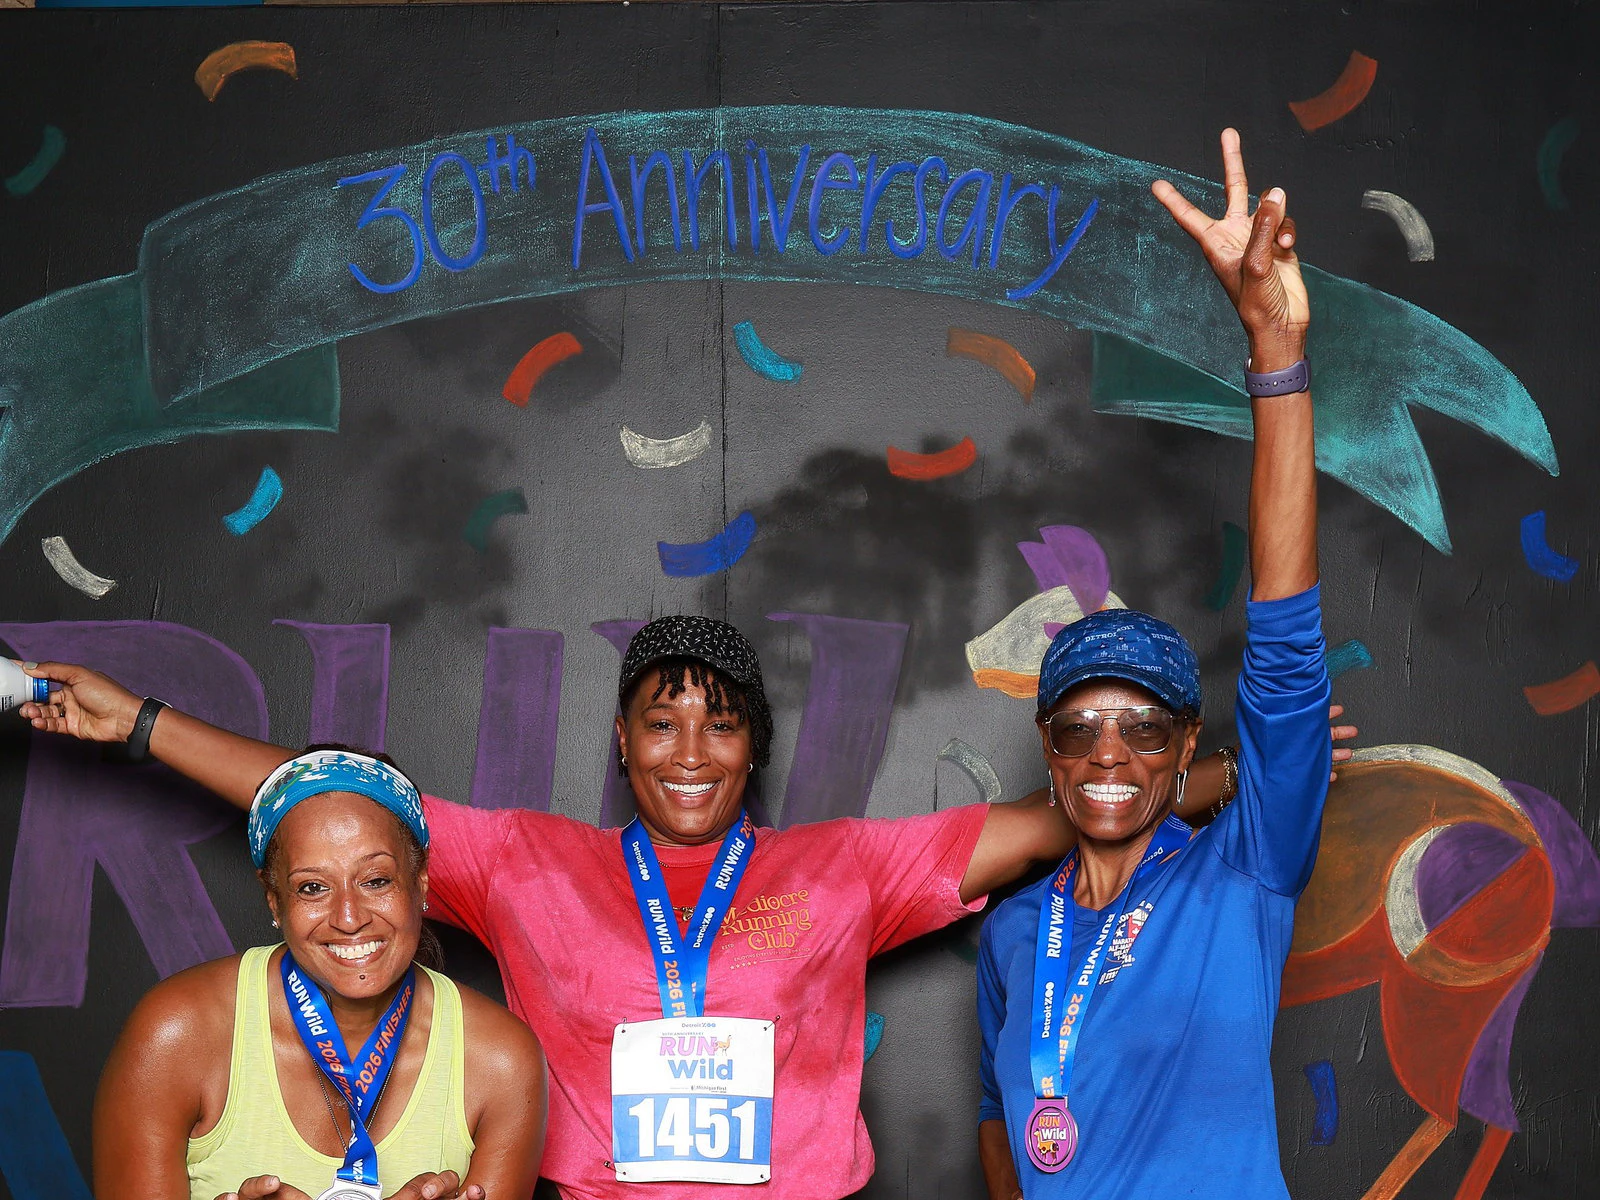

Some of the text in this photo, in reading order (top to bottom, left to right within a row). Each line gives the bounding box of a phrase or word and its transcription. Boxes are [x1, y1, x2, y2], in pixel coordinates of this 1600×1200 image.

[337, 127, 1099, 300] 30th Anniversary
[1053, 858, 1075, 893] 2026
[720, 908, 812, 936] Running
[723, 889, 810, 925] Mdiocre
[747, 926, 795, 951] Club
[663, 960, 683, 1000] 2026
[1059, 993, 1084, 1037] 2026
[355, 985, 412, 1094] 2026 FINISHER
[659, 1036, 717, 1056] RUN
[316, 1040, 345, 1074] 2026
[667, 1058, 733, 1080] Wild
[628, 1097, 756, 1160] 1451
[1038, 1116, 1060, 1127] RUN
[1041, 1127, 1067, 1140] Wild
